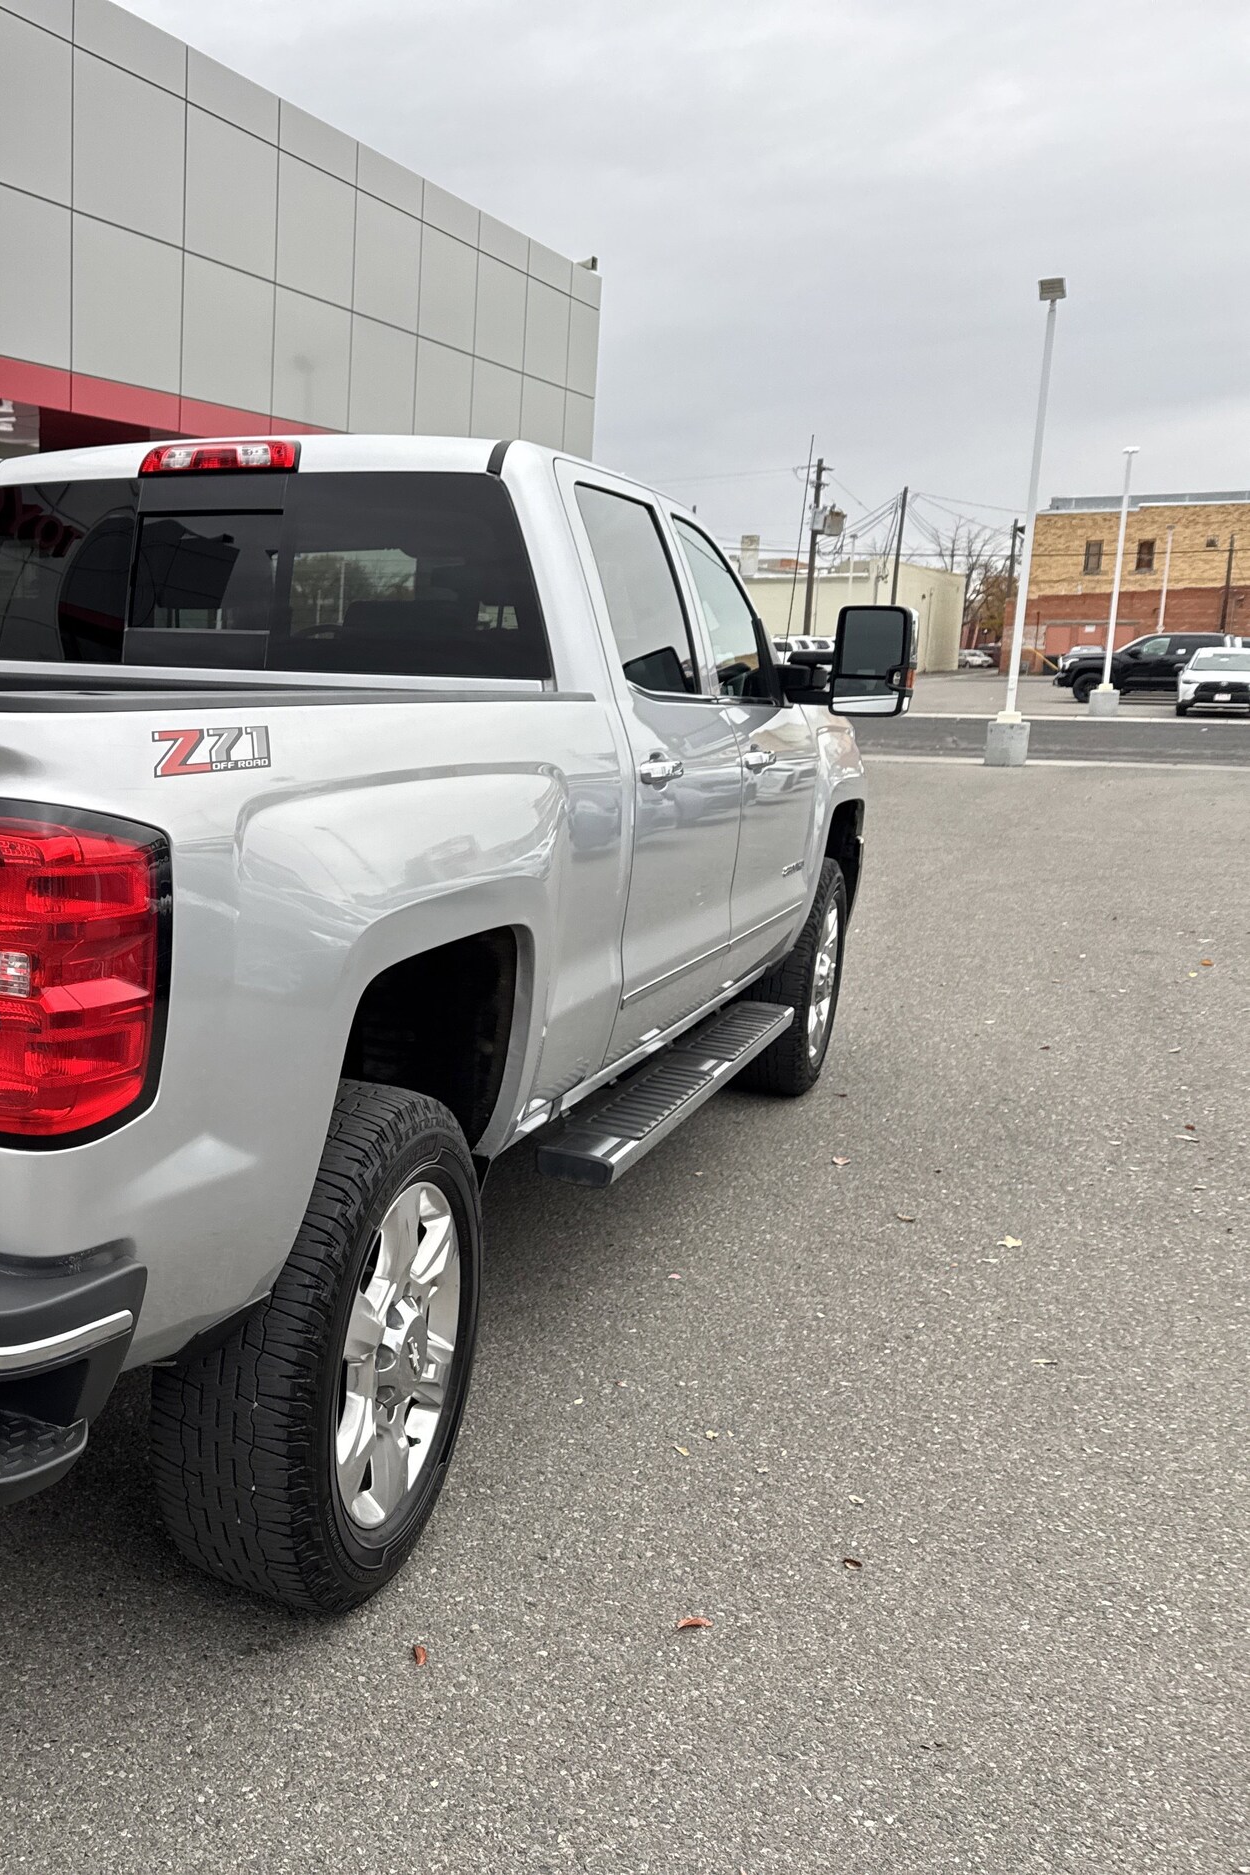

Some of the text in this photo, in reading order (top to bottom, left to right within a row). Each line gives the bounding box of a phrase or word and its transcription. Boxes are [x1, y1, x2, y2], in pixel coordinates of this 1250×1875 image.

[151, 725, 271, 778] Z71
[212, 758, 269, 771] OFF ROAD
